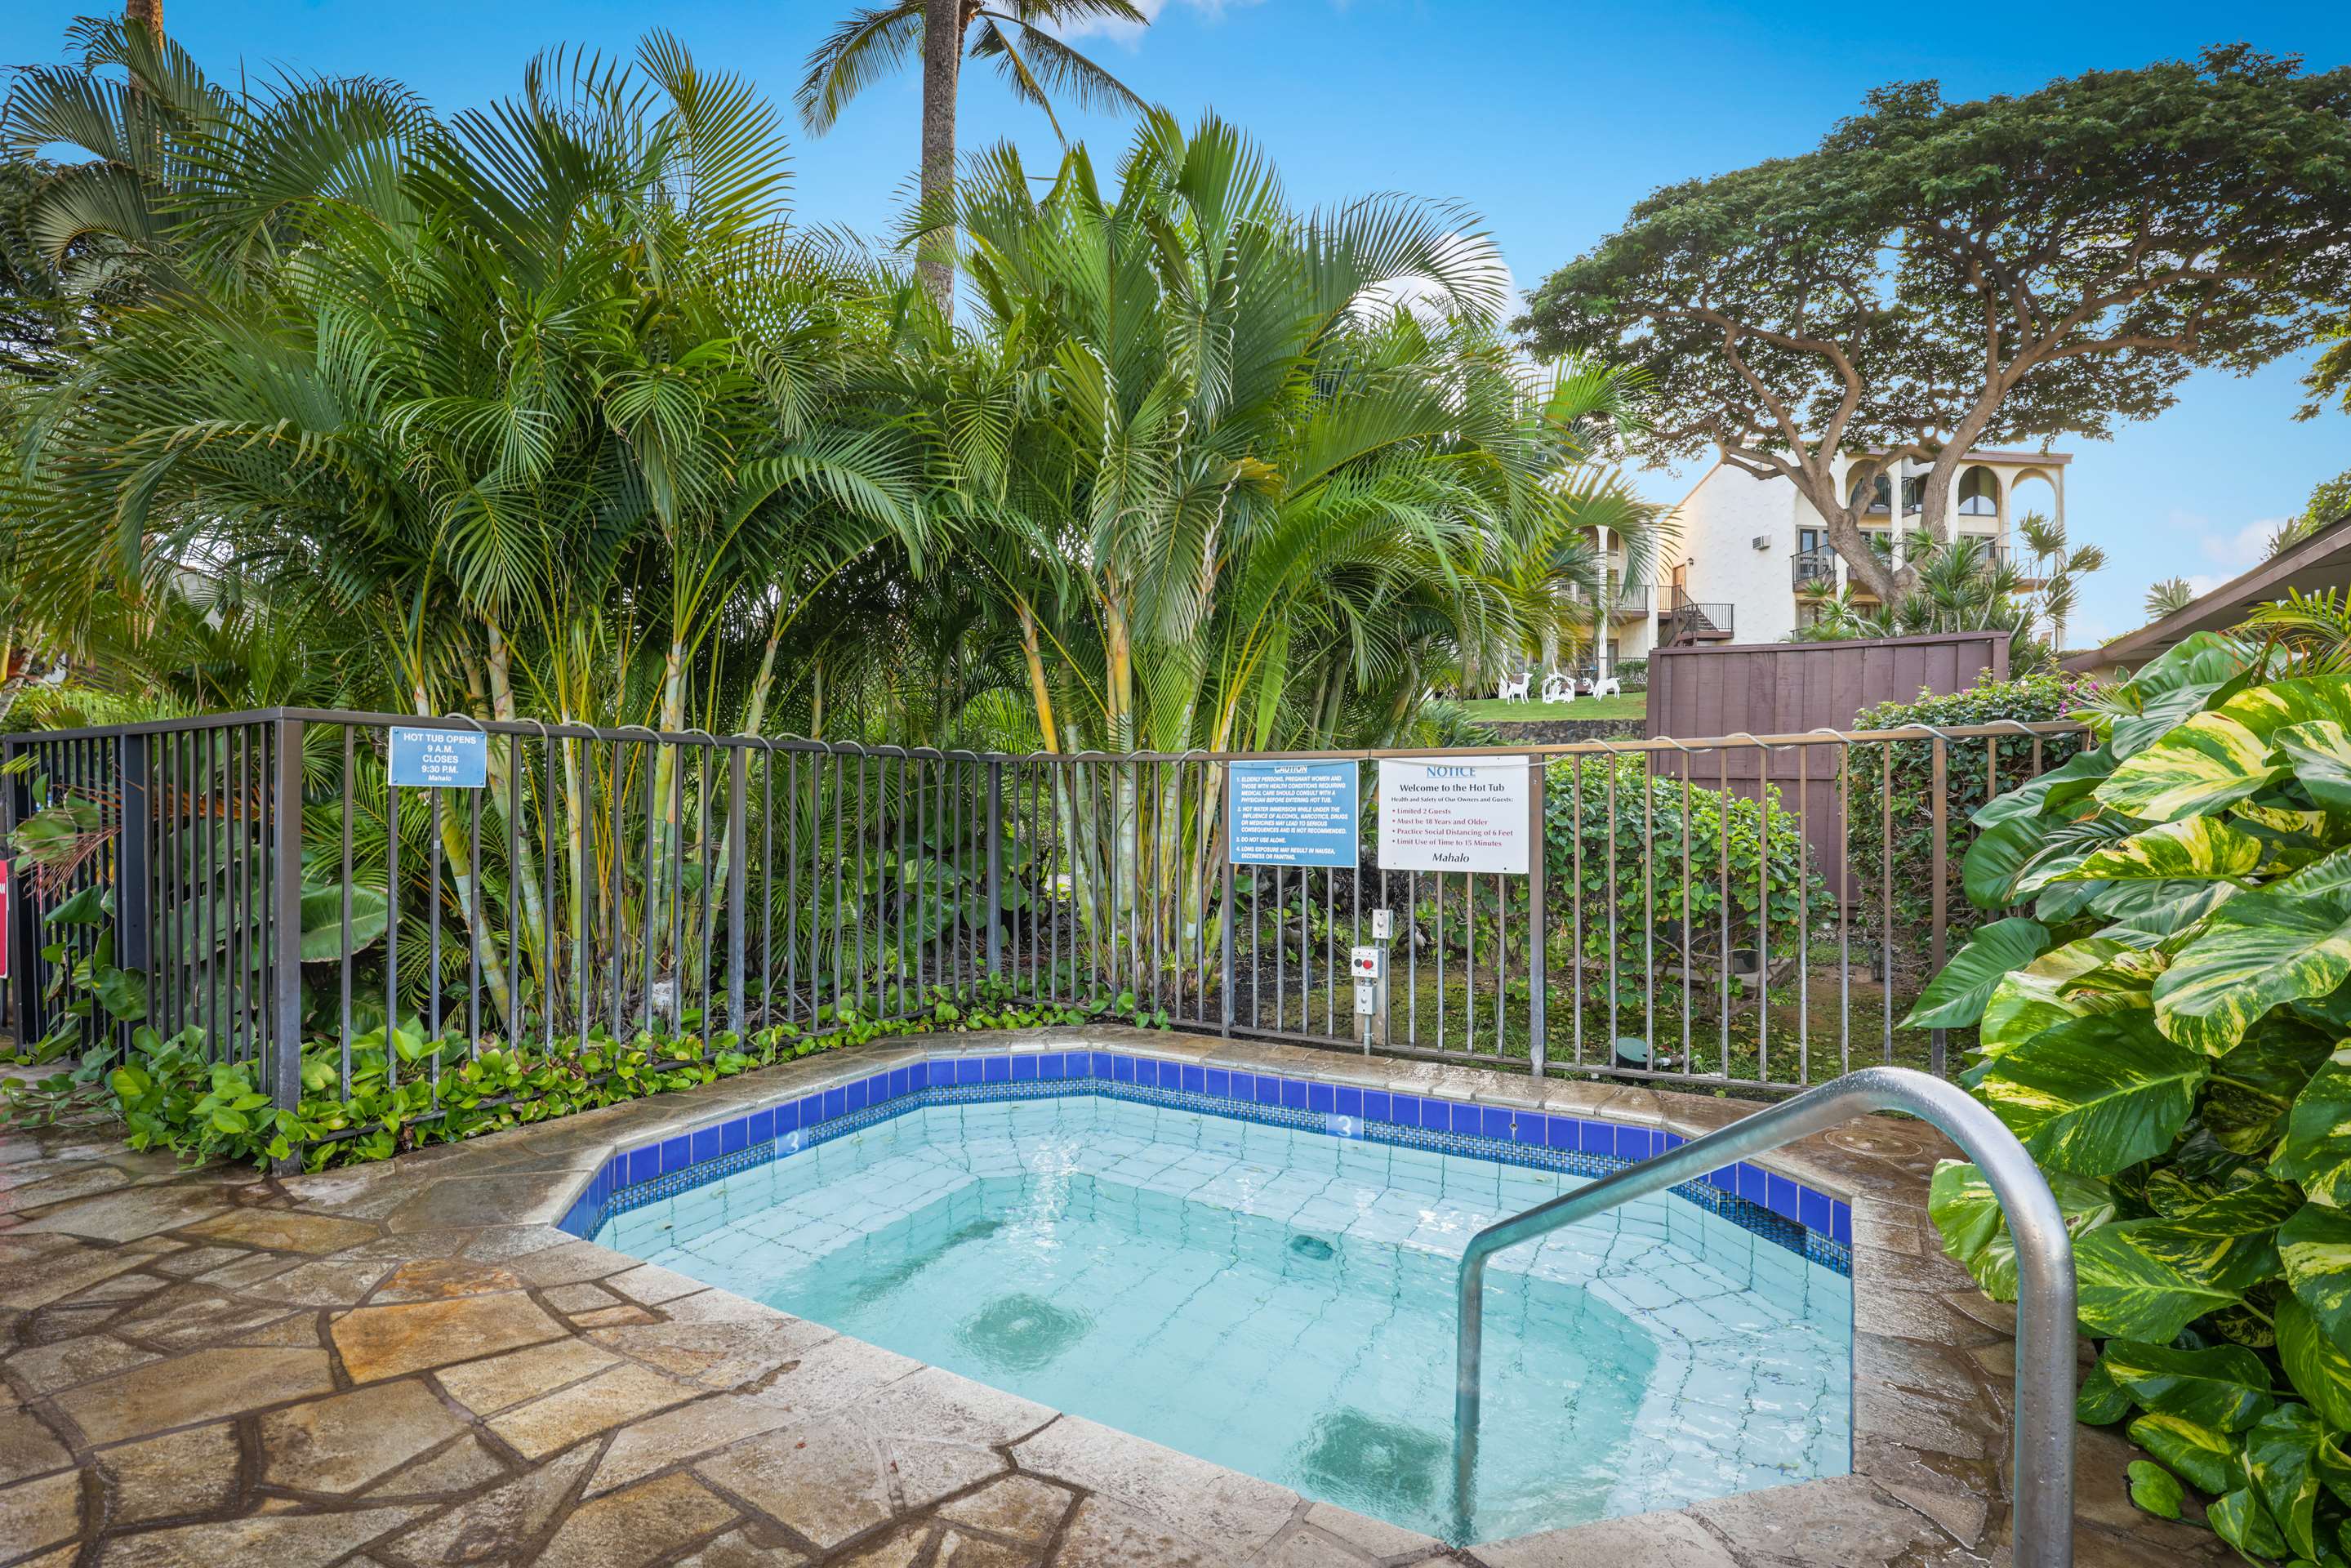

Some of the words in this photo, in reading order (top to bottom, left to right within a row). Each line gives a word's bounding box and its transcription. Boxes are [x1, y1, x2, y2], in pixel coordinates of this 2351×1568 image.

[403, 733, 423, 742] HOT
[425, 734, 443, 742] TUB
[446, 736, 476, 744] OPENS
[434, 745, 454, 753] A.M.
[422, 755, 458, 764] CLOSES
[421, 765, 439, 773] 9:30
[442, 765, 458, 773] P.M.
[1274, 765, 1307, 773] CAUTION
[1427, 766, 1476, 777] NOTICE
[1446, 829, 1482, 837] Distancing
[1432, 853, 1470, 862] Mahalo
[1338, 1115, 1352, 1137] 3
[786, 1130, 799, 1153] 3
